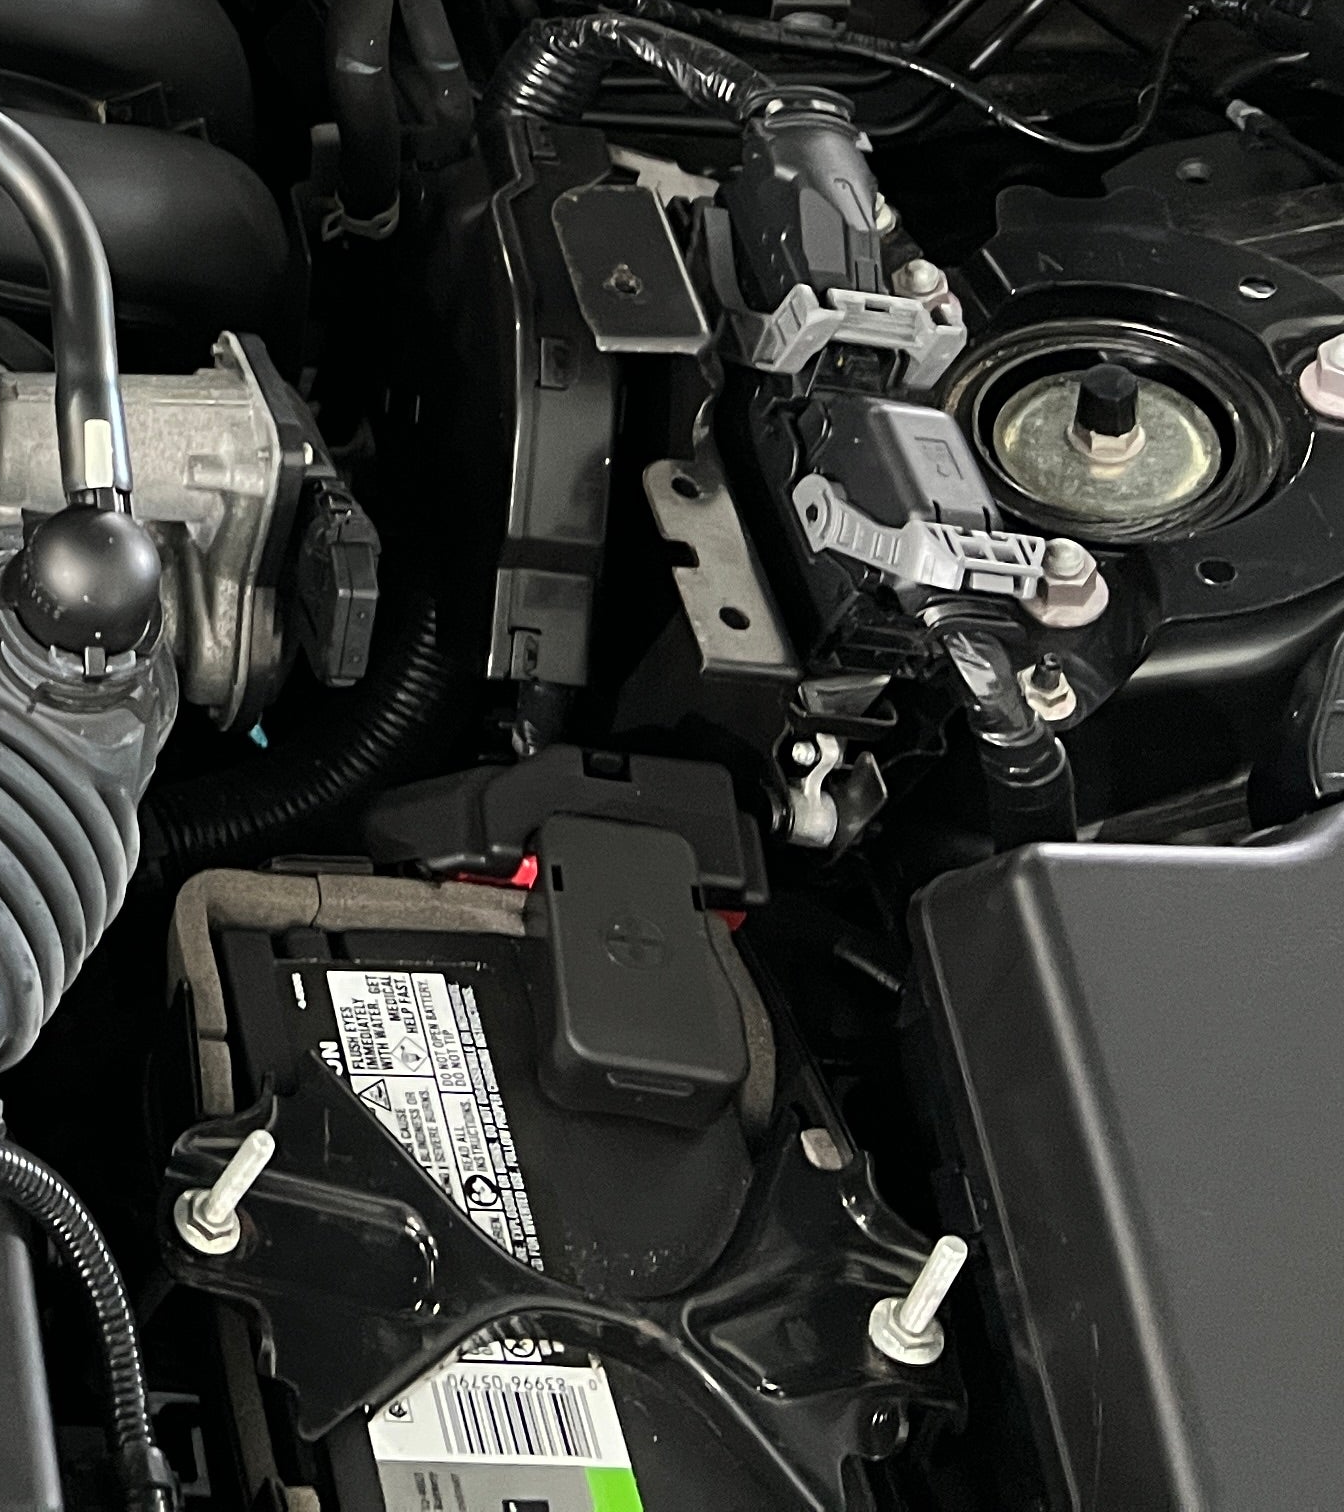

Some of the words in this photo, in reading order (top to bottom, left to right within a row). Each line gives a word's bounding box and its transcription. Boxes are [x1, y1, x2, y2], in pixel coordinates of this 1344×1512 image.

[364, 974, 380, 993] GET
[379, 976, 400, 1020] MEDICAL
[339, 1006, 356, 1031] EYES
[400, 1008, 418, 1033] HELP
[351, 998, 379, 1069] IMMEDIATELY
[427, 1024, 444, 1047] OPEN
[346, 1036, 365, 1068] FLUSH
[376, 1043, 393, 1069] WITH
[434, 1051, 449, 1068] NOT
[446, 1049, 461, 1068] NOT
[439, 1072, 453, 1086] DO
[452, 1072, 465, 1086] DO
[453, 1127, 466, 1142] ALL
[458, 1146, 474, 1171] READ
[447, 1373, 503, 1390] 05790
[510, 1375, 566, 1392] 83996
[588, 1378, 598, 1391] 0
